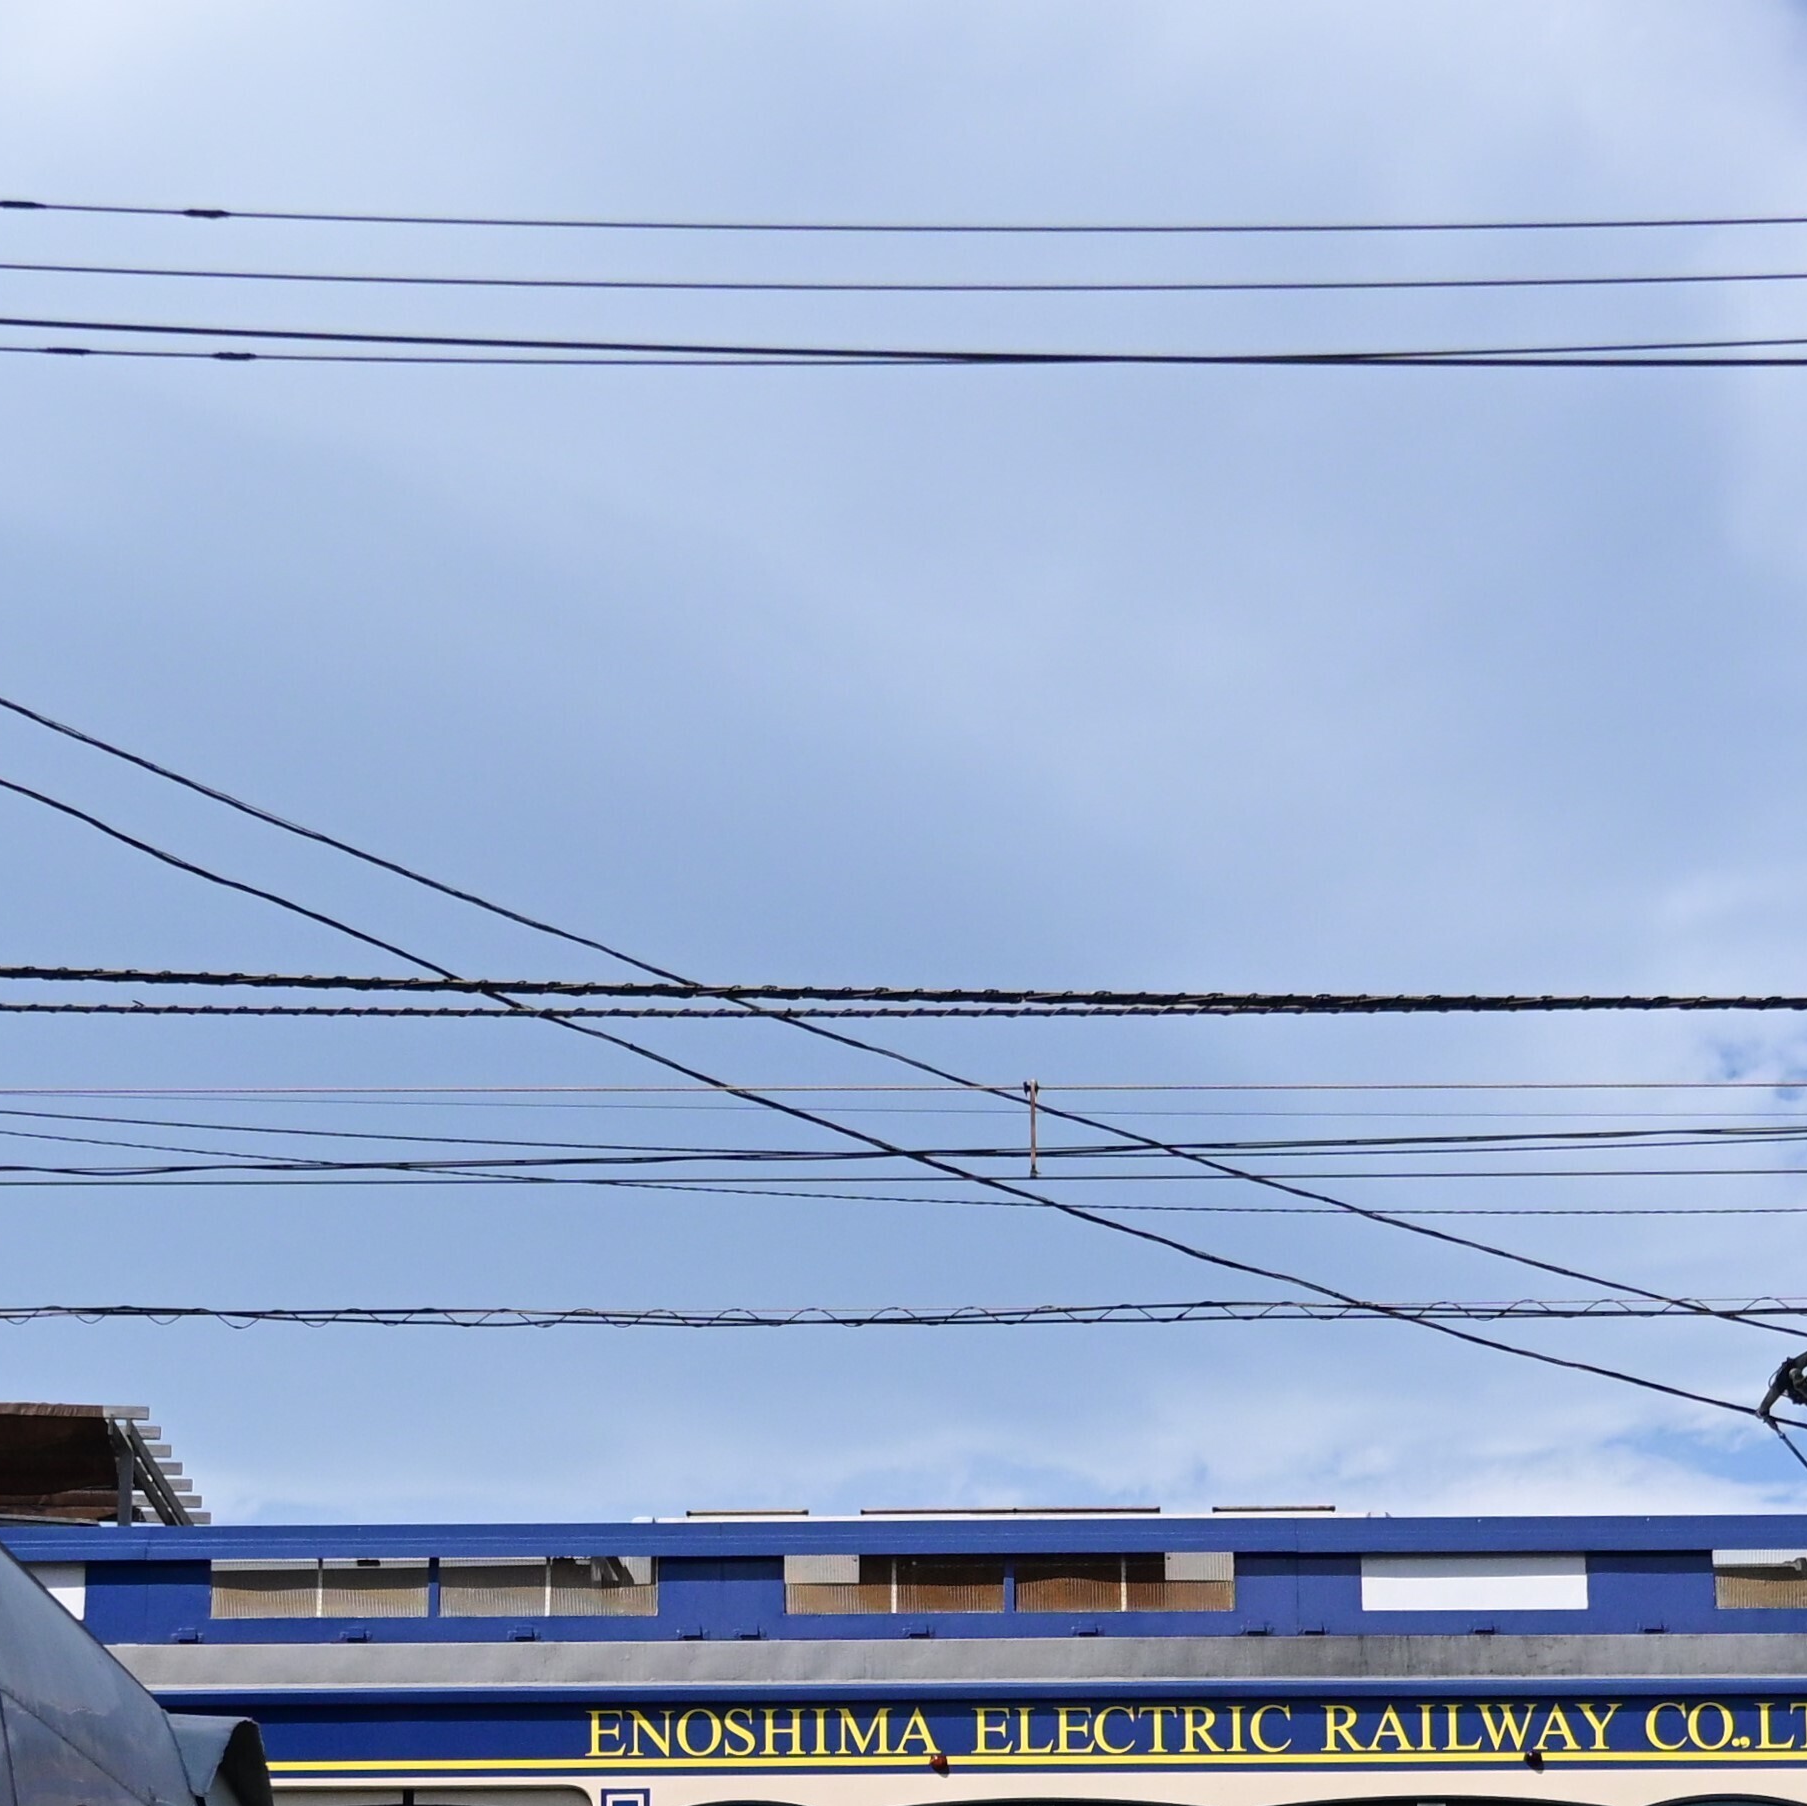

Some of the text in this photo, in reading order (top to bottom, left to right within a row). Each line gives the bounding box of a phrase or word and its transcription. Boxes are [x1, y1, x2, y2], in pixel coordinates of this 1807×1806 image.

[585, 1706, 941, 1757] ENOSHIMA
[970, 1704, 1292, 1756] ELECTRIC
[1322, 1702, 1621, 1753] RAILWAY
